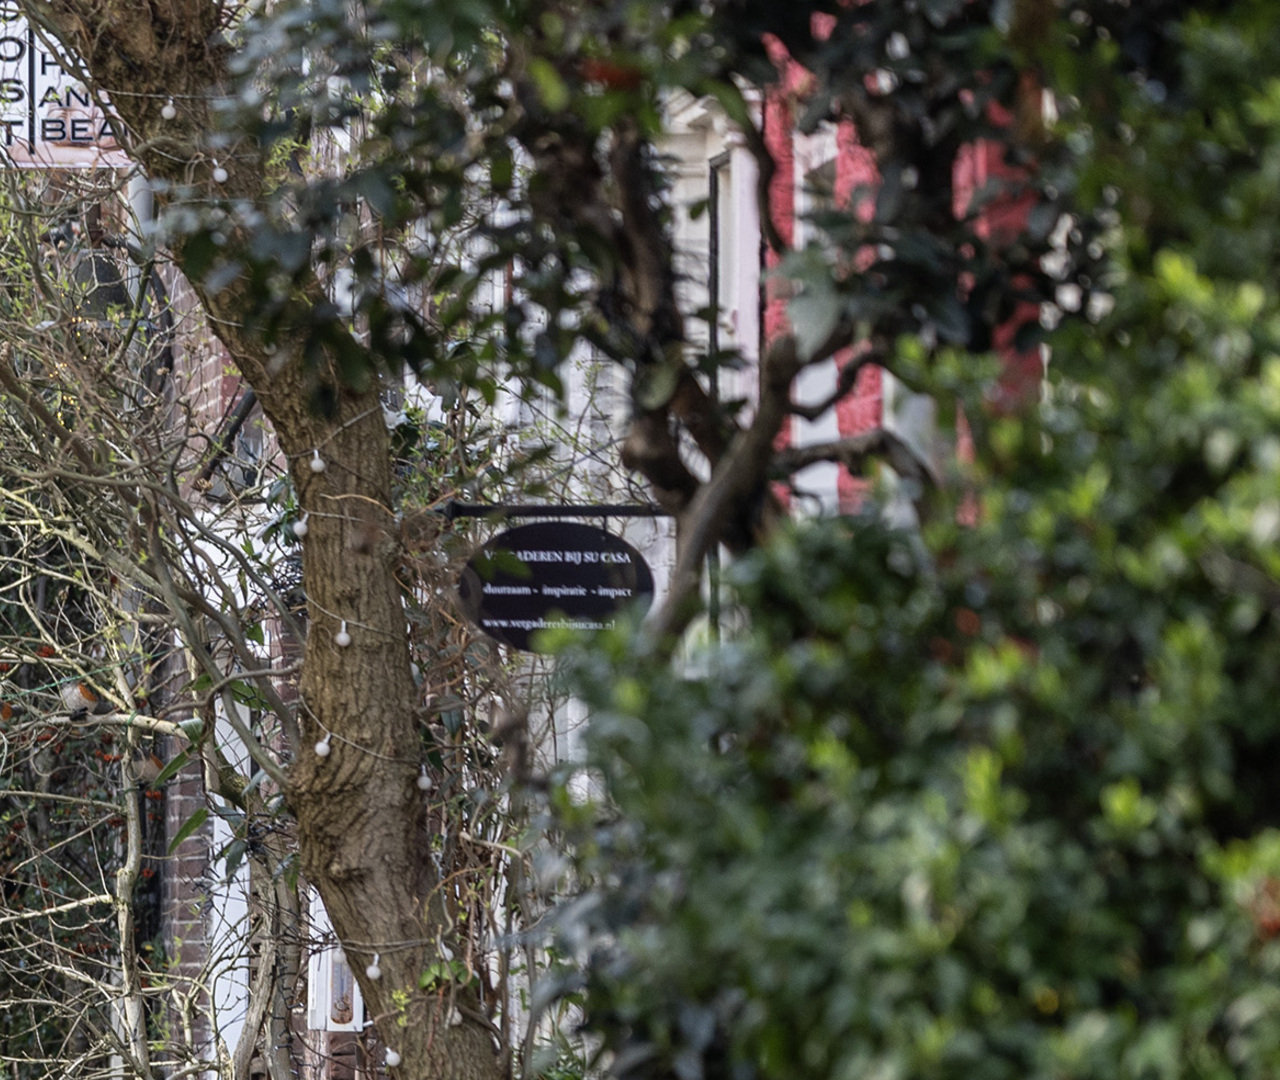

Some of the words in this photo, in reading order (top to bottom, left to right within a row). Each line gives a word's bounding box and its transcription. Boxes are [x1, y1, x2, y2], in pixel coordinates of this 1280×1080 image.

[41, 119, 128, 141] BEA
[484, 549, 562, 563] VADEREN
[583, 552, 599, 563] SU
[600, 552, 632, 564] CASA
[482, 582, 532, 595] duurzaam
[542, 584, 588, 598] inspiratie
[598, 585, 632, 599] impact
